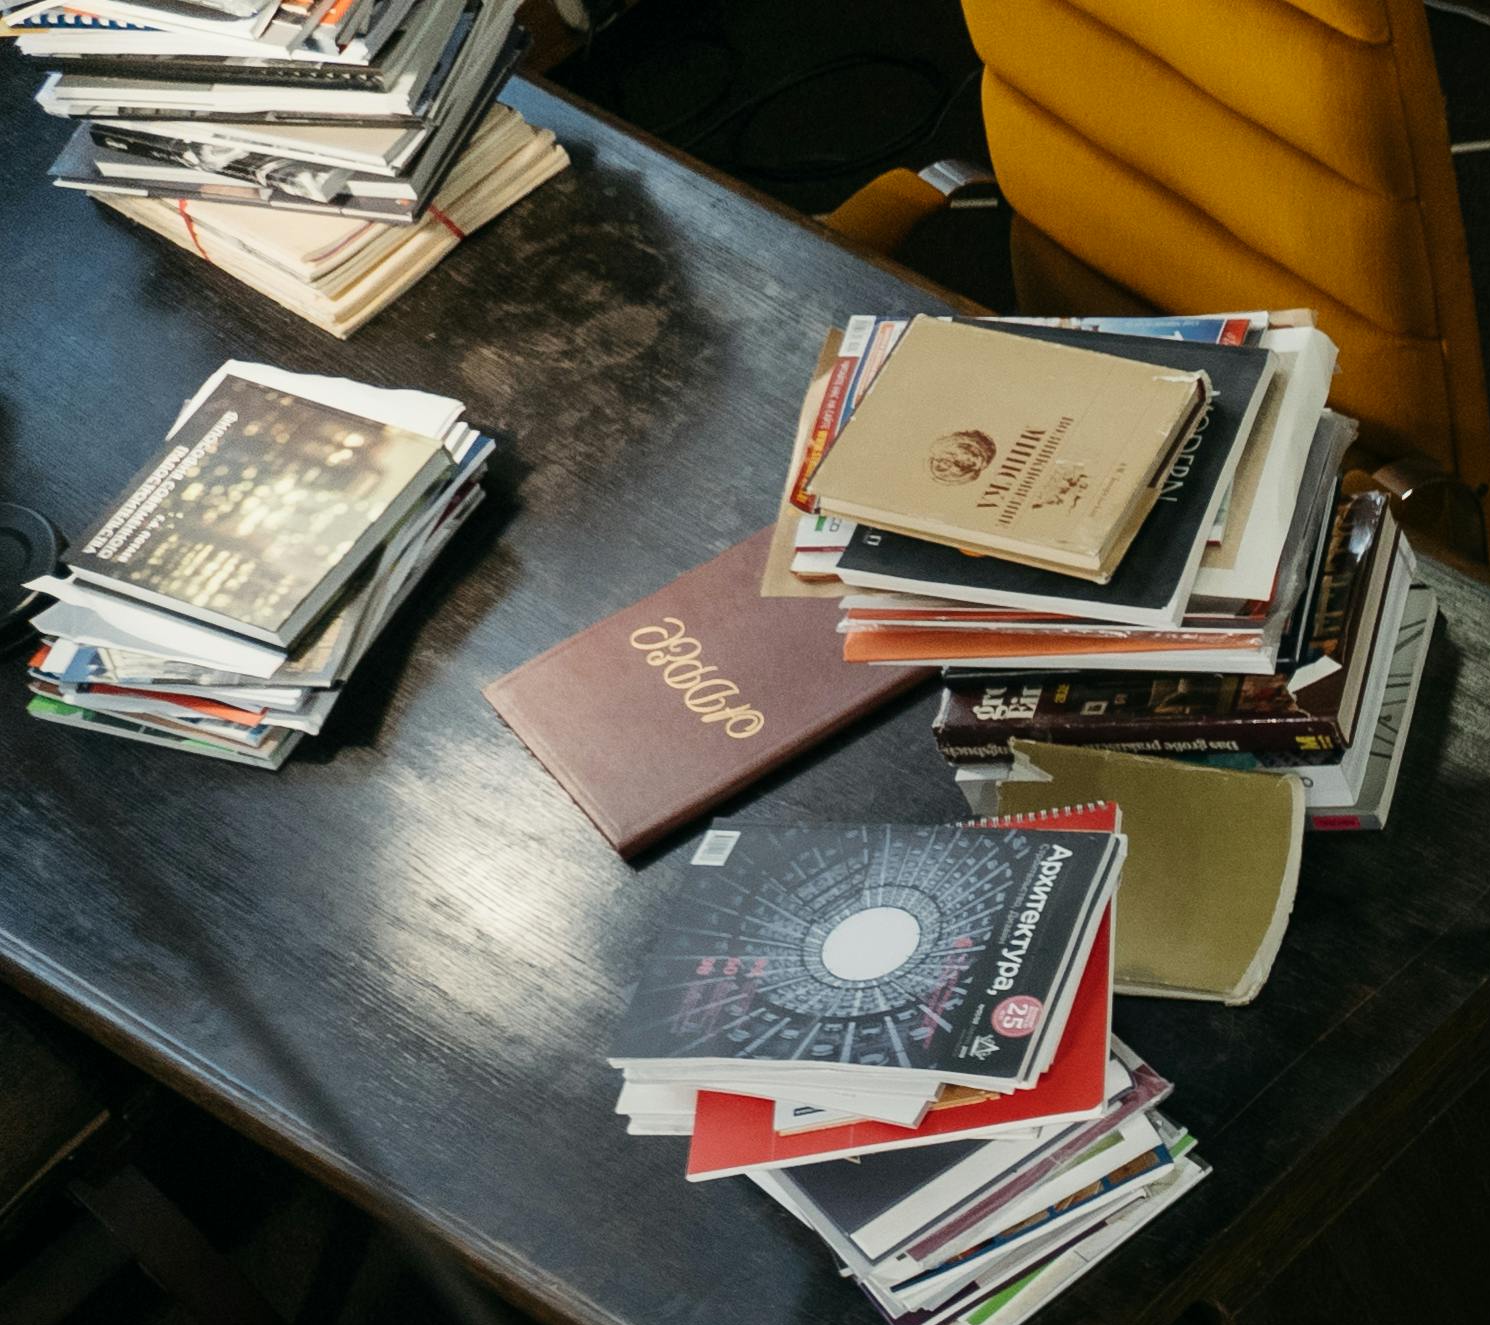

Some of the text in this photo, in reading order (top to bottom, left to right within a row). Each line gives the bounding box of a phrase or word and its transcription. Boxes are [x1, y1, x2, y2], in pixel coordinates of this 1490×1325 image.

[94, 407, 240, 563] ФИЛОСОФИЯ СОВРЕМЕННОГО
[975, 420, 1046, 517] МИНСКА
[1212, 738, 1241, 753] Das
[984, 840, 1074, 1002] Архитектура,
[995, 840, 1051, 947] Строительство, Дизайн
[999, 997, 1030, 1033] 25
